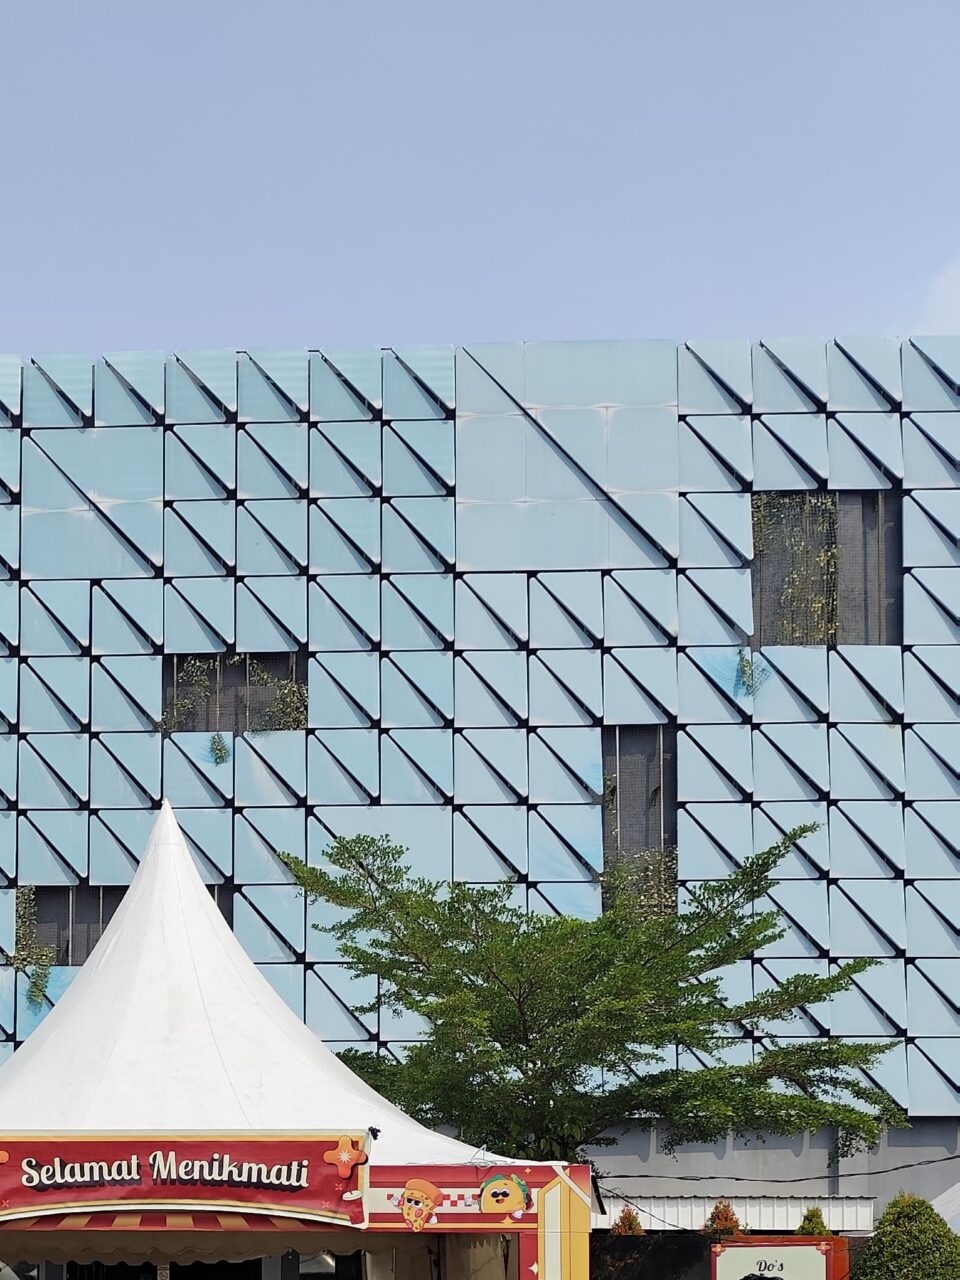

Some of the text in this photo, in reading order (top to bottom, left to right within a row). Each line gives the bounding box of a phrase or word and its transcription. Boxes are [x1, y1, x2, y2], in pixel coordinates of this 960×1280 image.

[21, 1150, 309, 1188] Selamat Menikmati
[756, 1259, 784, 1272] Do's
